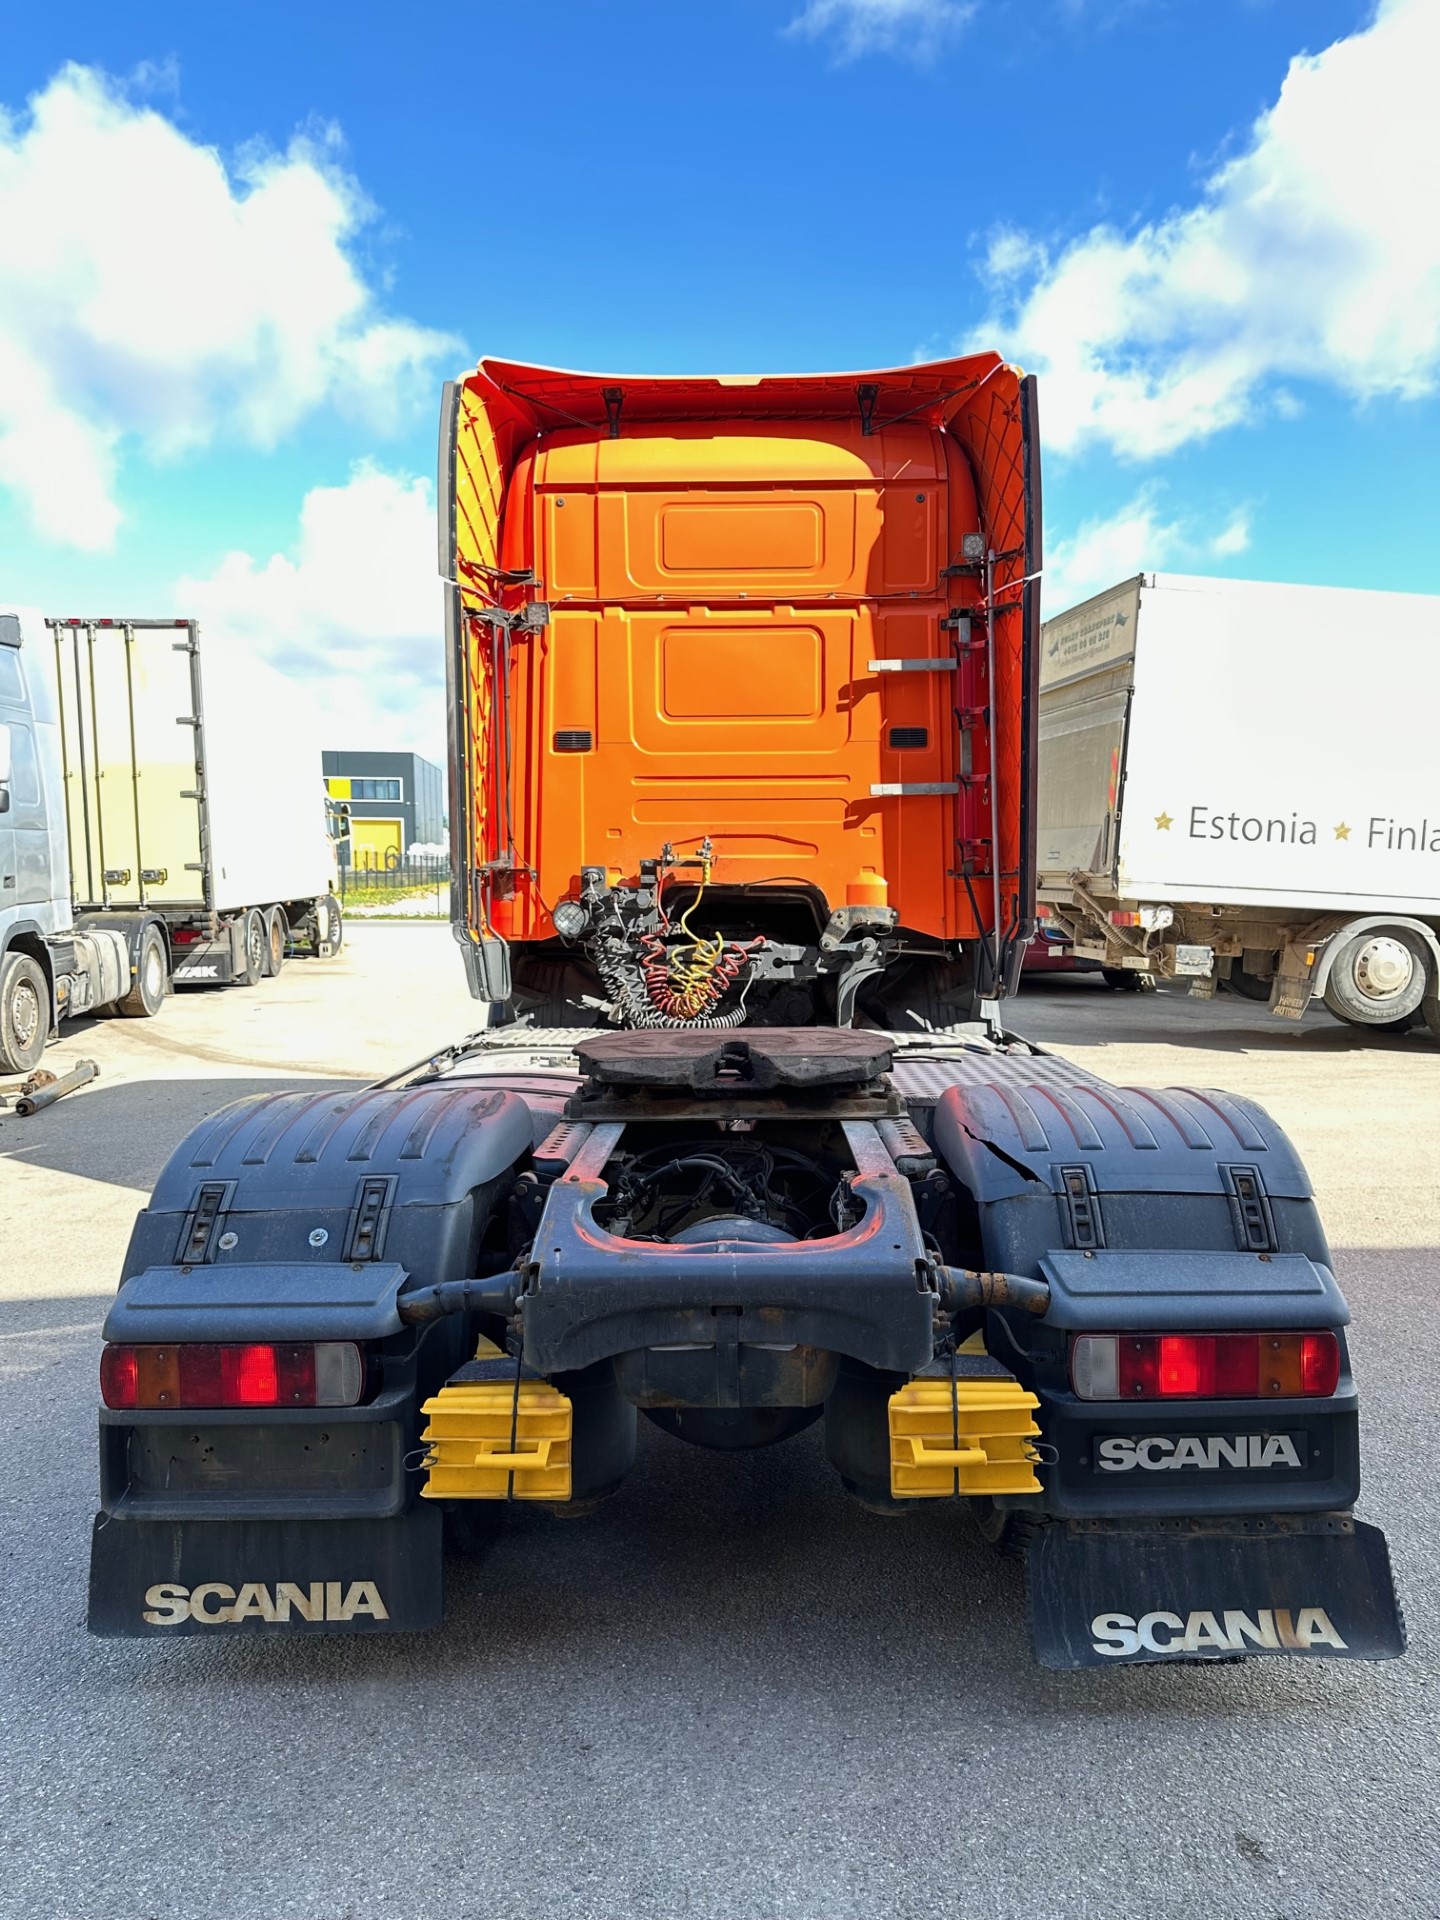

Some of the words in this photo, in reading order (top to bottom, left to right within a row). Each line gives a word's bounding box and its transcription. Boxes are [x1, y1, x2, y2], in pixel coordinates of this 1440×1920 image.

[1189, 806, 1316, 844] Estonia
[1368, 817, 1440, 852] Finla
[1099, 1434, 1301, 1471] SCANIA
[143, 1581, 390, 1625] SCANIA
[1091, 1607, 1349, 1656] SCANIA
